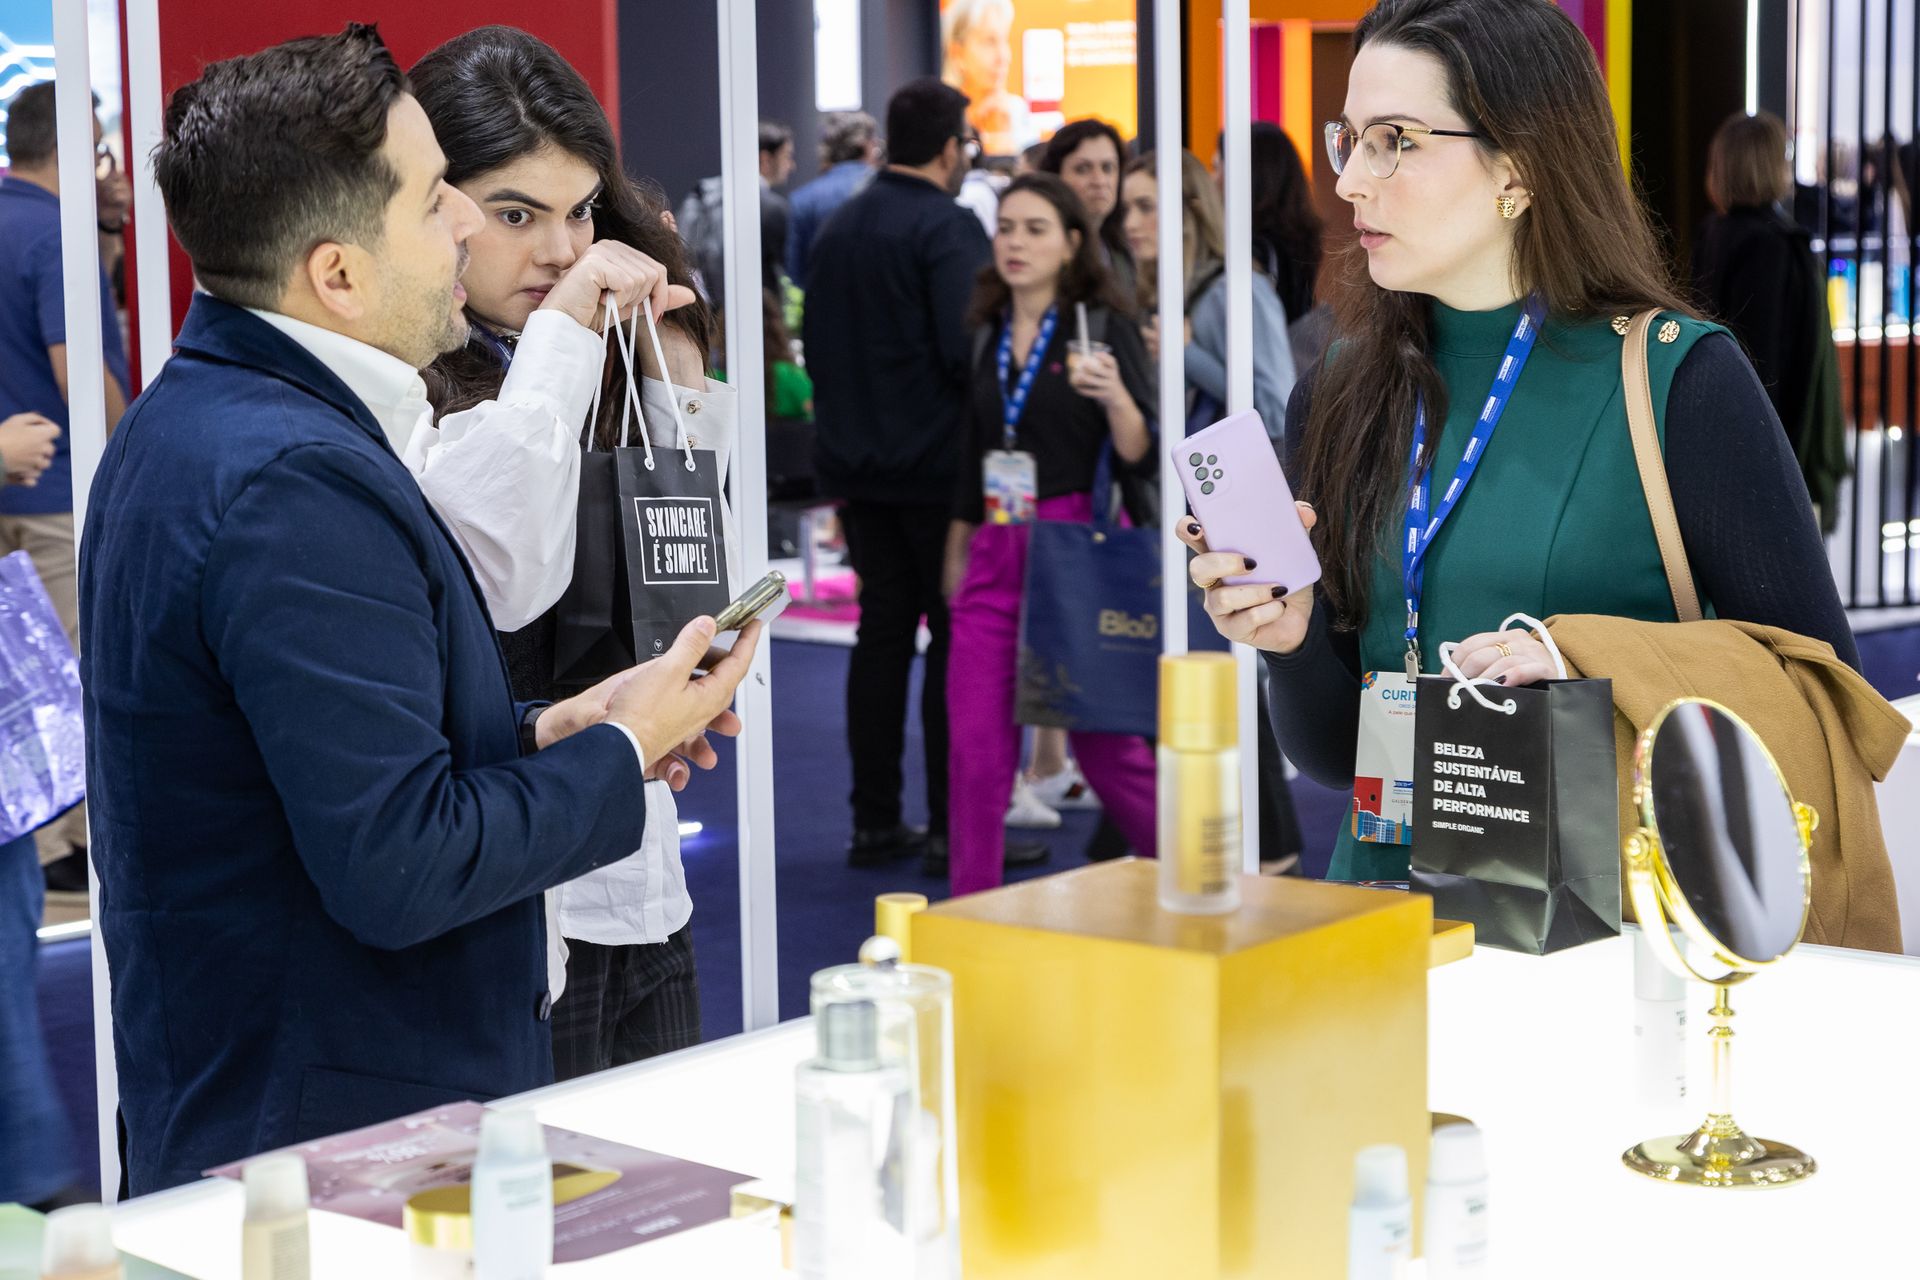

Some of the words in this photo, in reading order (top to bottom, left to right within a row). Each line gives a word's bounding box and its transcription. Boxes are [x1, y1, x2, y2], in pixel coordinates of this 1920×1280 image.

[645, 507, 708, 538] SKINCARE
[653, 539, 662, 574] É
[665, 543, 709, 574] SIMPLE
[1382, 689, 1417, 701] CURIT
[1433, 742, 1485, 760] BELEZA
[1433, 761, 1526, 785] SUSTENTÁVEL
[1433, 779, 1454, 793] DE
[1454, 782, 1487, 798] ALTA
[1433, 798, 1530, 823] PERFORMANCE
[1432, 821, 1457, 830] SIMPLE
[1457, 824, 1485, 834] ORGANIC
